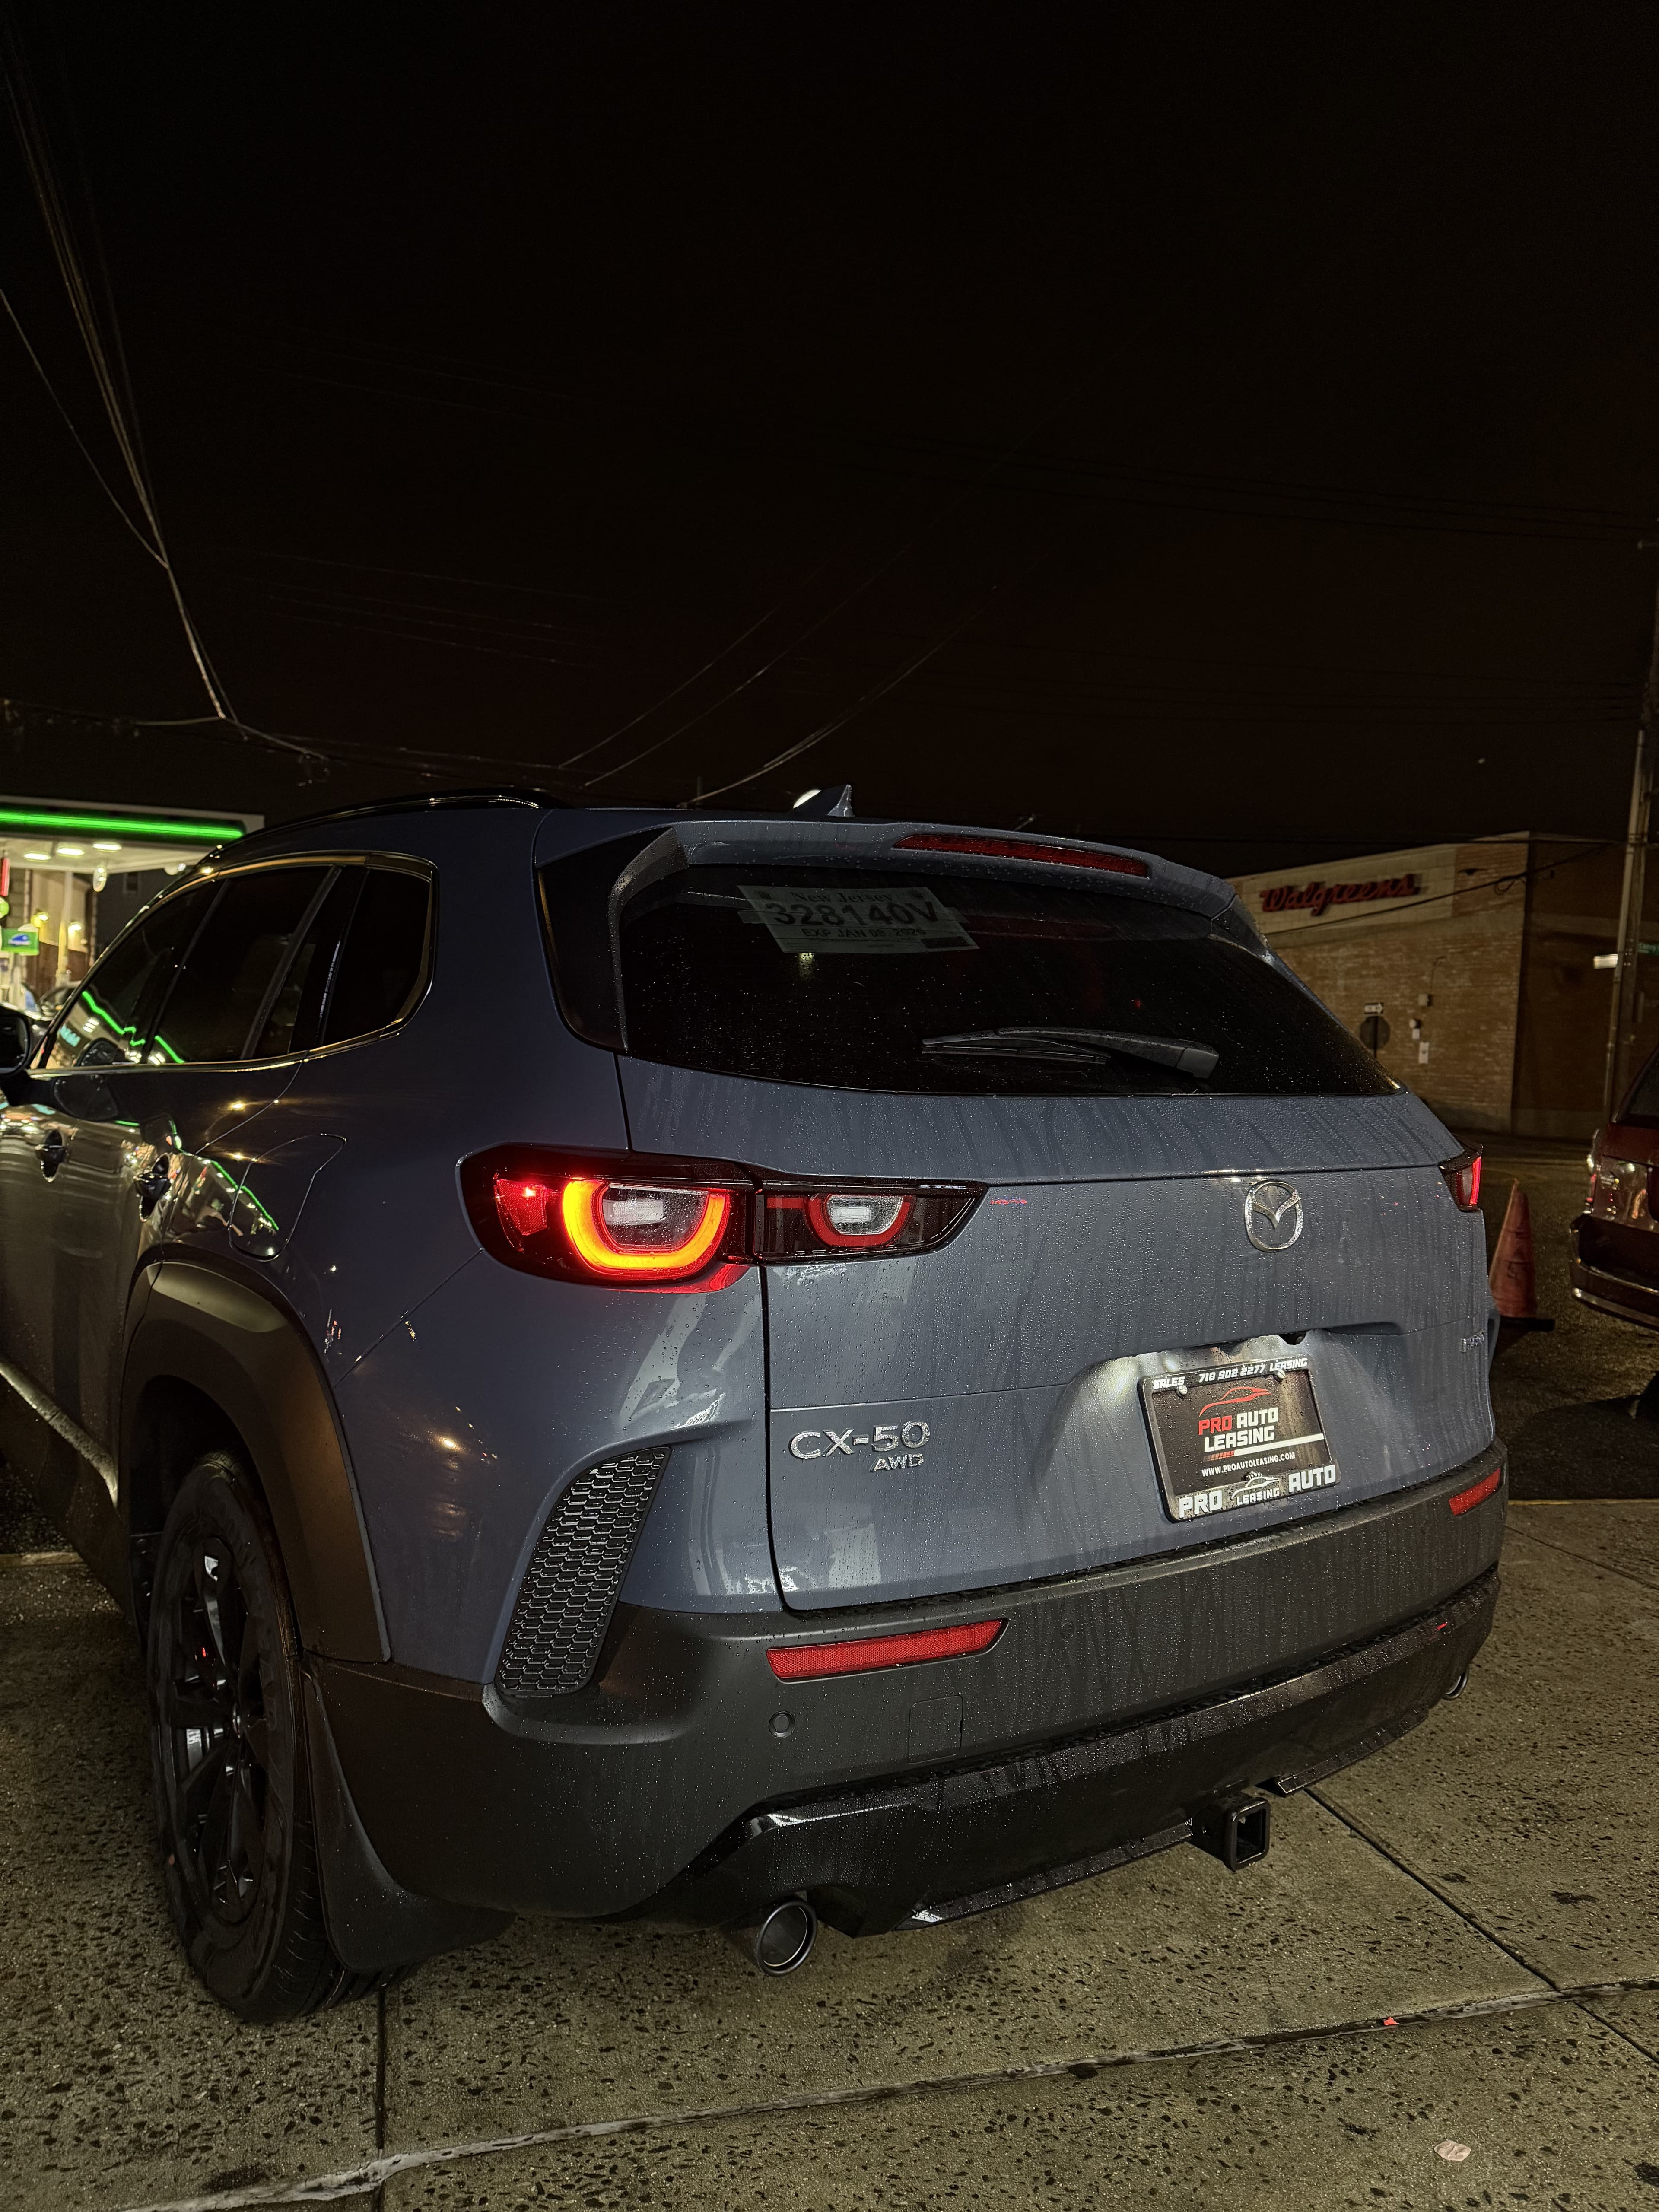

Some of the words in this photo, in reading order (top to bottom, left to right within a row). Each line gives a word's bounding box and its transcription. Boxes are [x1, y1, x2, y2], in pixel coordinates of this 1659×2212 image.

[790, 892, 830, 902] New
[836, 892, 892, 903] Jersey
[1259, 874, 1421, 917] Walgreens
[765, 901, 938, 926] 328140V
[837, 929, 867, 937] JAN
[1153, 1376, 1185, 1389] SALES
[1198, 1372, 1216, 1382] 718
[1218, 1367, 1238, 1380] 902
[1240, 1364, 1266, 1376] 2277
[1269, 1358, 1308, 1372] LEASING
[1198, 1415, 1233, 1435] PRO
[1236, 1407, 1279, 1429] AUTO
[788, 1421, 931, 1460] CX-50
[1204, 1425, 1275, 1452] LEASING
[869, 1453, 925, 1472] AWD
[1201, 1451, 1296, 1477] WWW.PROAUTOLEASING.COM
[1179, 1490, 1223, 1519] PRO
[1236, 1487, 1280, 1506] LEASING
[1288, 1464, 1336, 1493] AUTO
